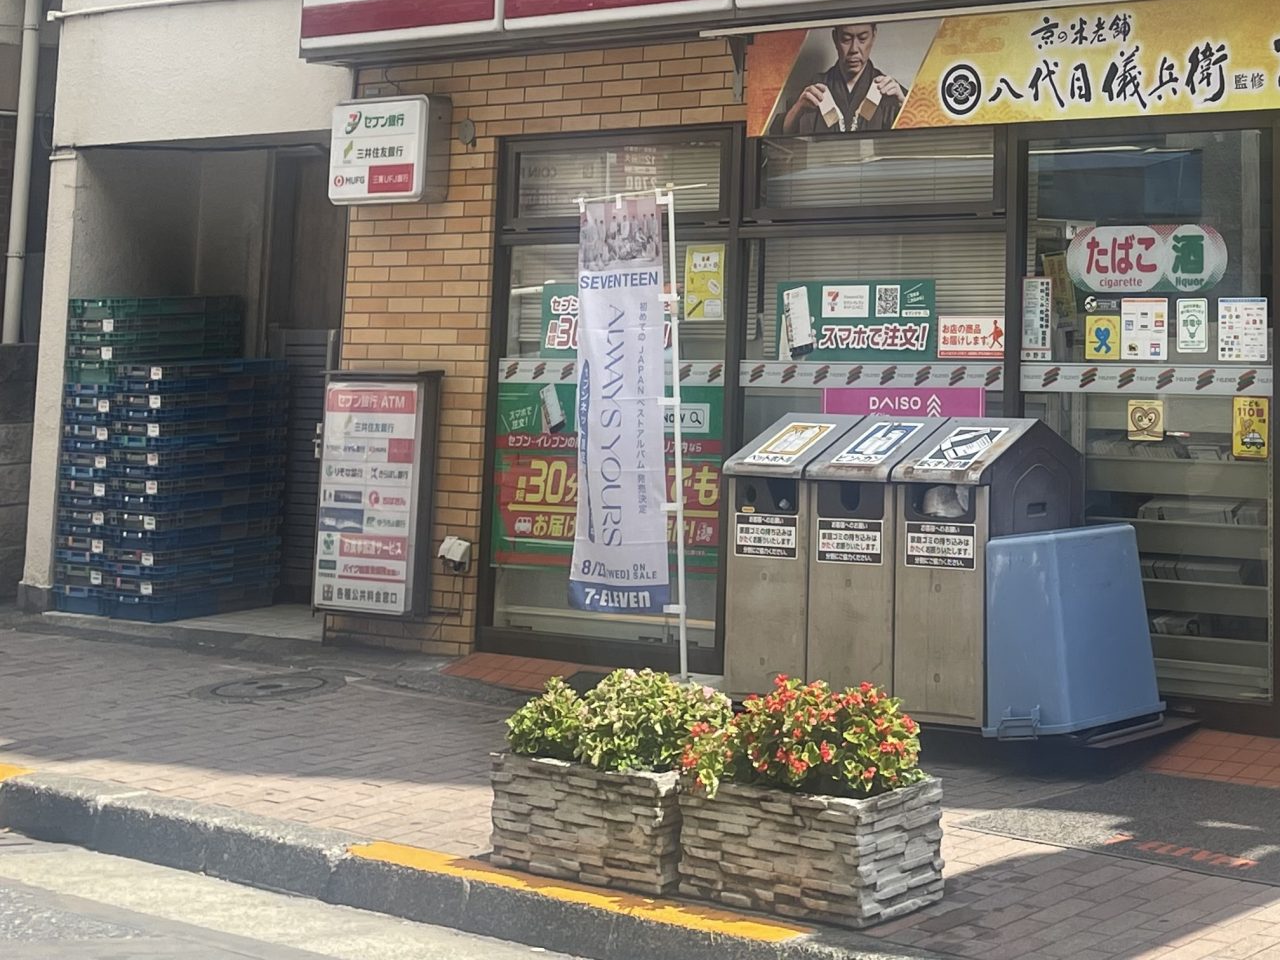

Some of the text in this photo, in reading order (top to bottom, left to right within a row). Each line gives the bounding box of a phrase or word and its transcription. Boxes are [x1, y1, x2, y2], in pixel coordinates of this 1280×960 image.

[364, 114, 405, 128] セブン銀行
[356, 146, 404, 160] 三井住友銀行
[1086, 234, 1204, 274] たばこ 酒
[580, 271, 658, 290] SEVENTEEN
[1100, 276, 1204, 288] cigarette liquor
[942, 324, 981, 334] お店の商品
[820, 324, 929, 350] スマホで注文!
[380, 395, 405, 409] ATM
[869, 396, 921, 410] DAISO
[600, 304, 625, 547] ALWAYS YOURS
[633, 571, 657, 580] SALE
